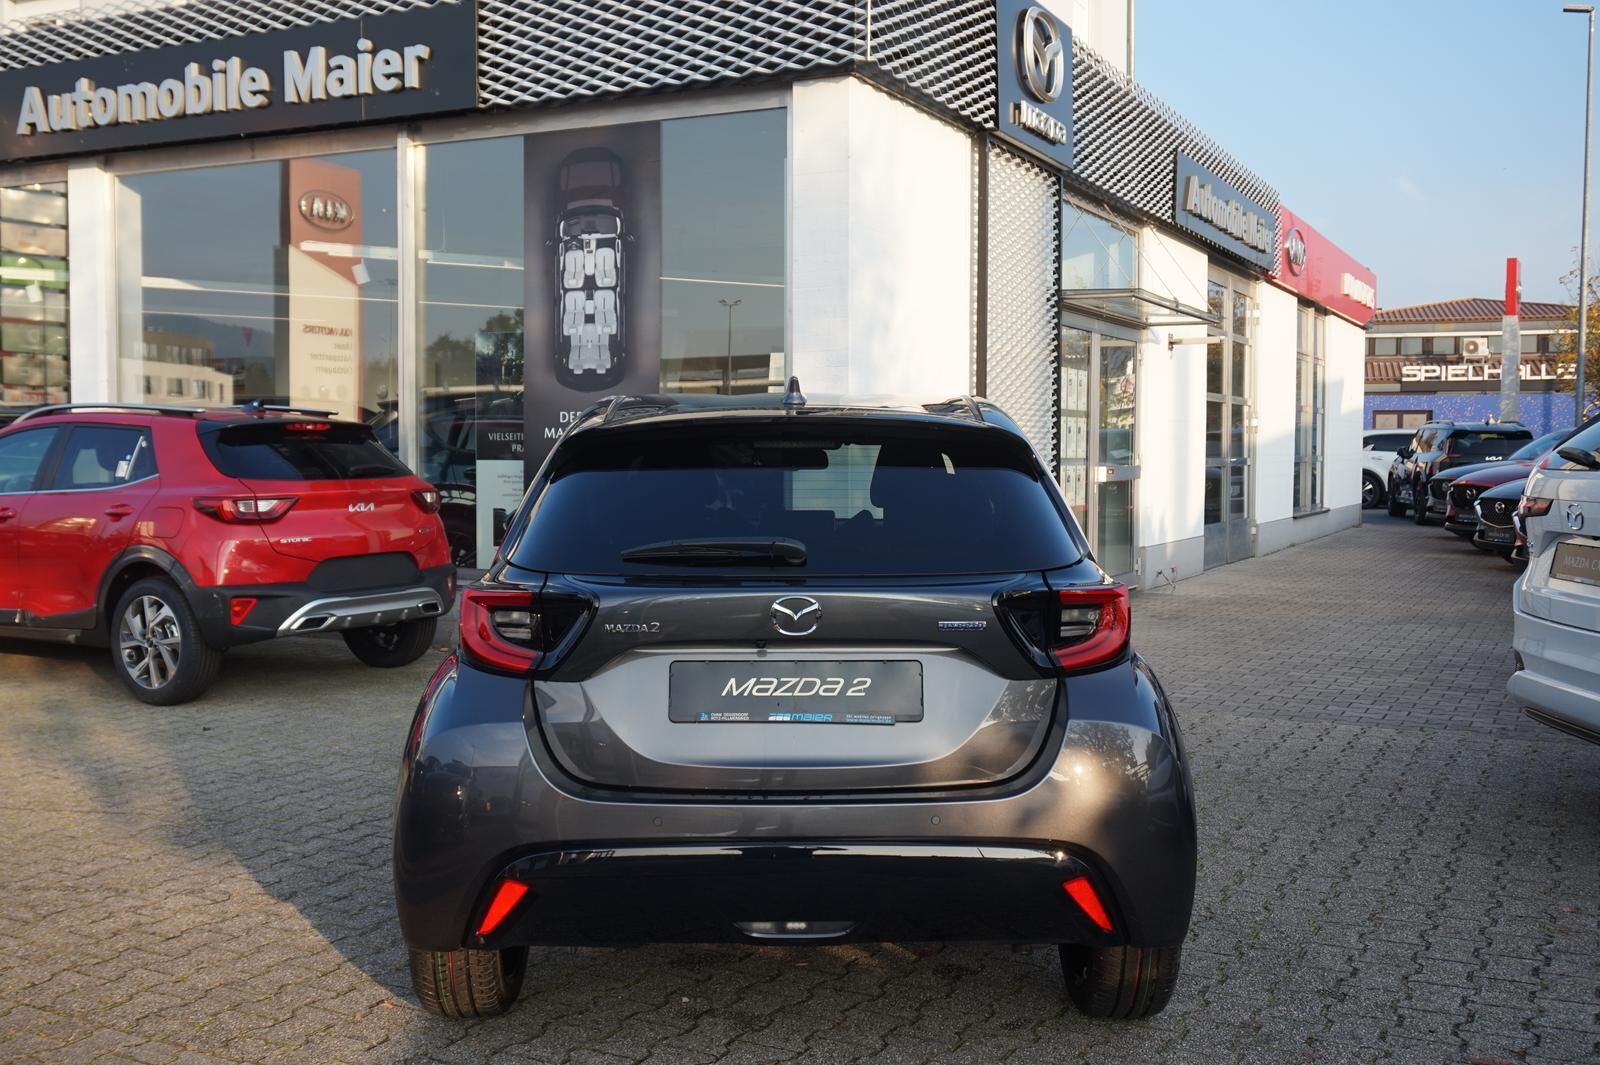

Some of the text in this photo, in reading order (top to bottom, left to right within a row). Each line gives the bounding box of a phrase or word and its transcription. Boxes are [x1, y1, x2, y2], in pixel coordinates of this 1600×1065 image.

[16, 37, 430, 135] Automobile Maier
[1184, 175, 1249, 243] Automobile
[544, 427, 566, 439] MA
[348, 502, 376, 512] KIA
[846, 677, 872, 697] 2
